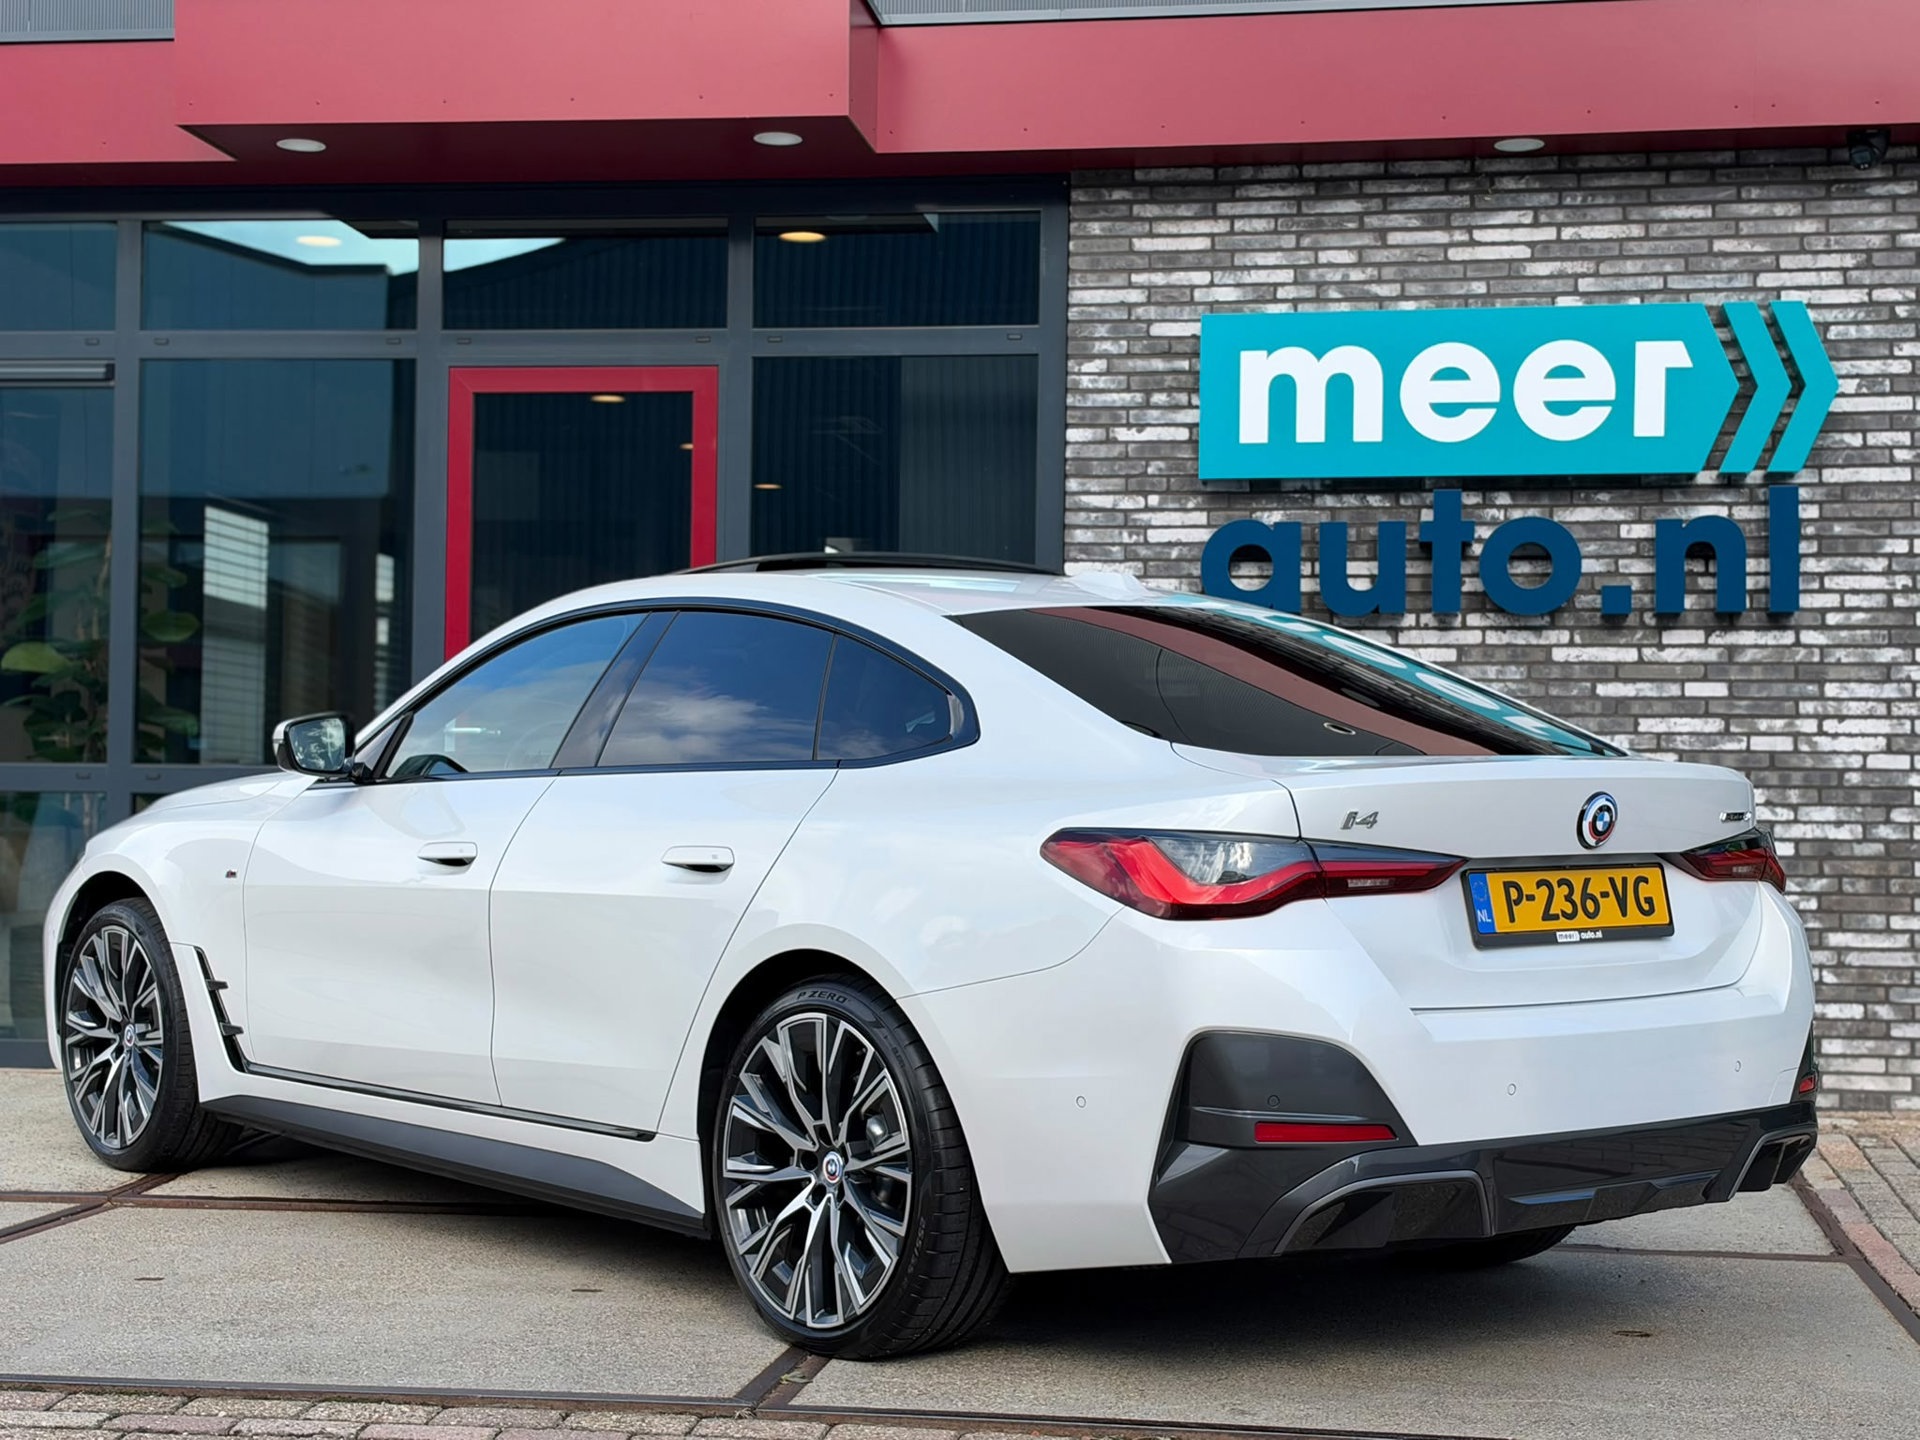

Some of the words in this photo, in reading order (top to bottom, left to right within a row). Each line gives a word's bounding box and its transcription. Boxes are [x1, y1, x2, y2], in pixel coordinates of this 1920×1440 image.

[1238, 339, 1694, 444] meer
[1201, 485, 1801, 617] auto.nl
[1340, 811, 1379, 830] i4
[1477, 909, 1492, 923] NL
[1502, 876, 1656, 924] P-236-VG
[808, 990, 849, 1004] ZERO
